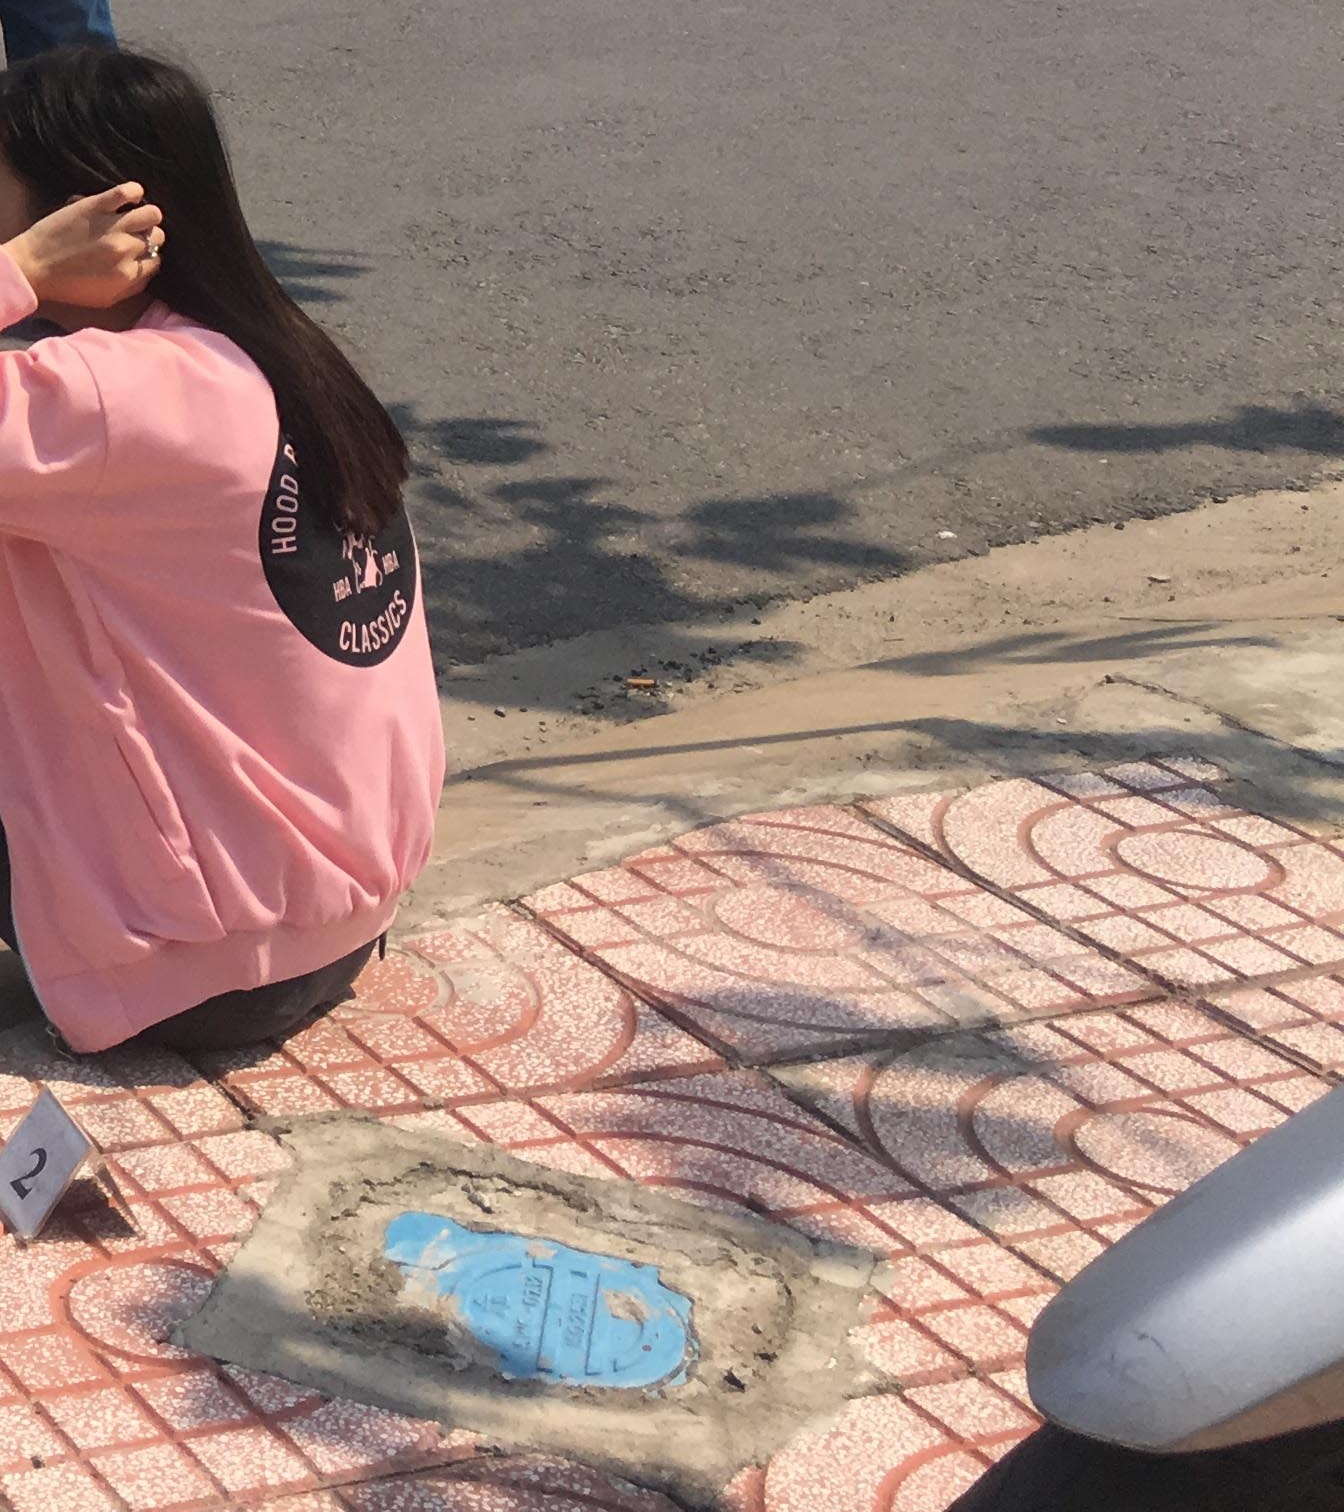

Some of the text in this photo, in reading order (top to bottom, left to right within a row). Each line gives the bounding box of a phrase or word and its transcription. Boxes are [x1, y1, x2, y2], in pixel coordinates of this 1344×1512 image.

[271, 473, 299, 555] HOOD
[339, 589, 407, 654] CLASSICS
[9, 1147, 48, 1201] 2
